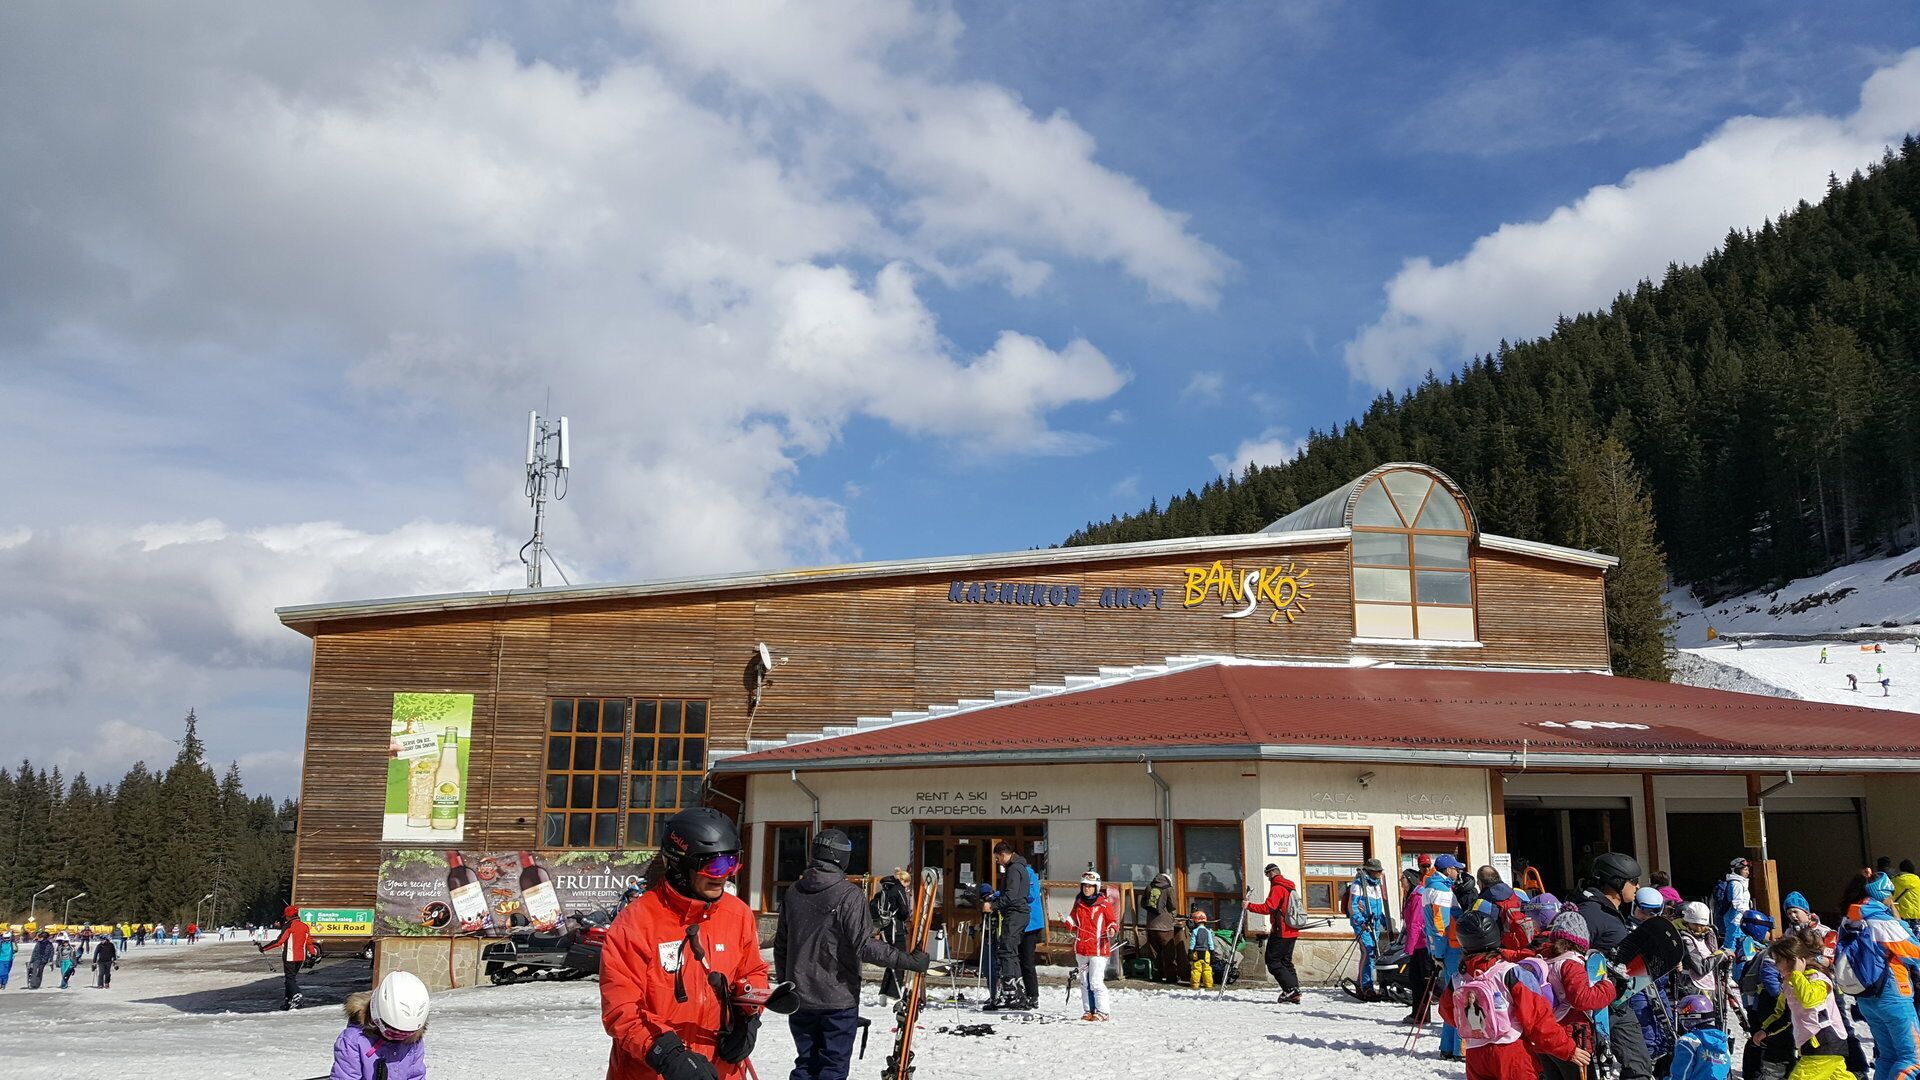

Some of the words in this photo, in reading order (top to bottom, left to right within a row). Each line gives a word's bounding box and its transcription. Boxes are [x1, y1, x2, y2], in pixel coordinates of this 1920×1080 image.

[948, 580, 1080, 607] КАБИНКОВ
[1099, 587, 1165, 610] ЛИФТ
[1183, 560, 1298, 618] BANSKO
[916, 792, 949, 801] RENT
[954, 792, 964, 801] A
[968, 791, 988, 801] SKI
[1000, 791, 1038, 801] SHOP
[890, 805, 915, 815] СКИ
[918, 805, 987, 815] ГАРДЕРОБ
[1000, 804, 1071, 815] МАГАЗИН
[1300, 808, 1368, 820] TICKETS
[1397, 808, 1463, 821] TICKETS
[383, 880, 408, 891] Your
[410, 881, 432, 890] recipe
[432, 879, 447, 890] for
[396, 890, 415, 899] cozy
[417, 889, 442, 897] winter
